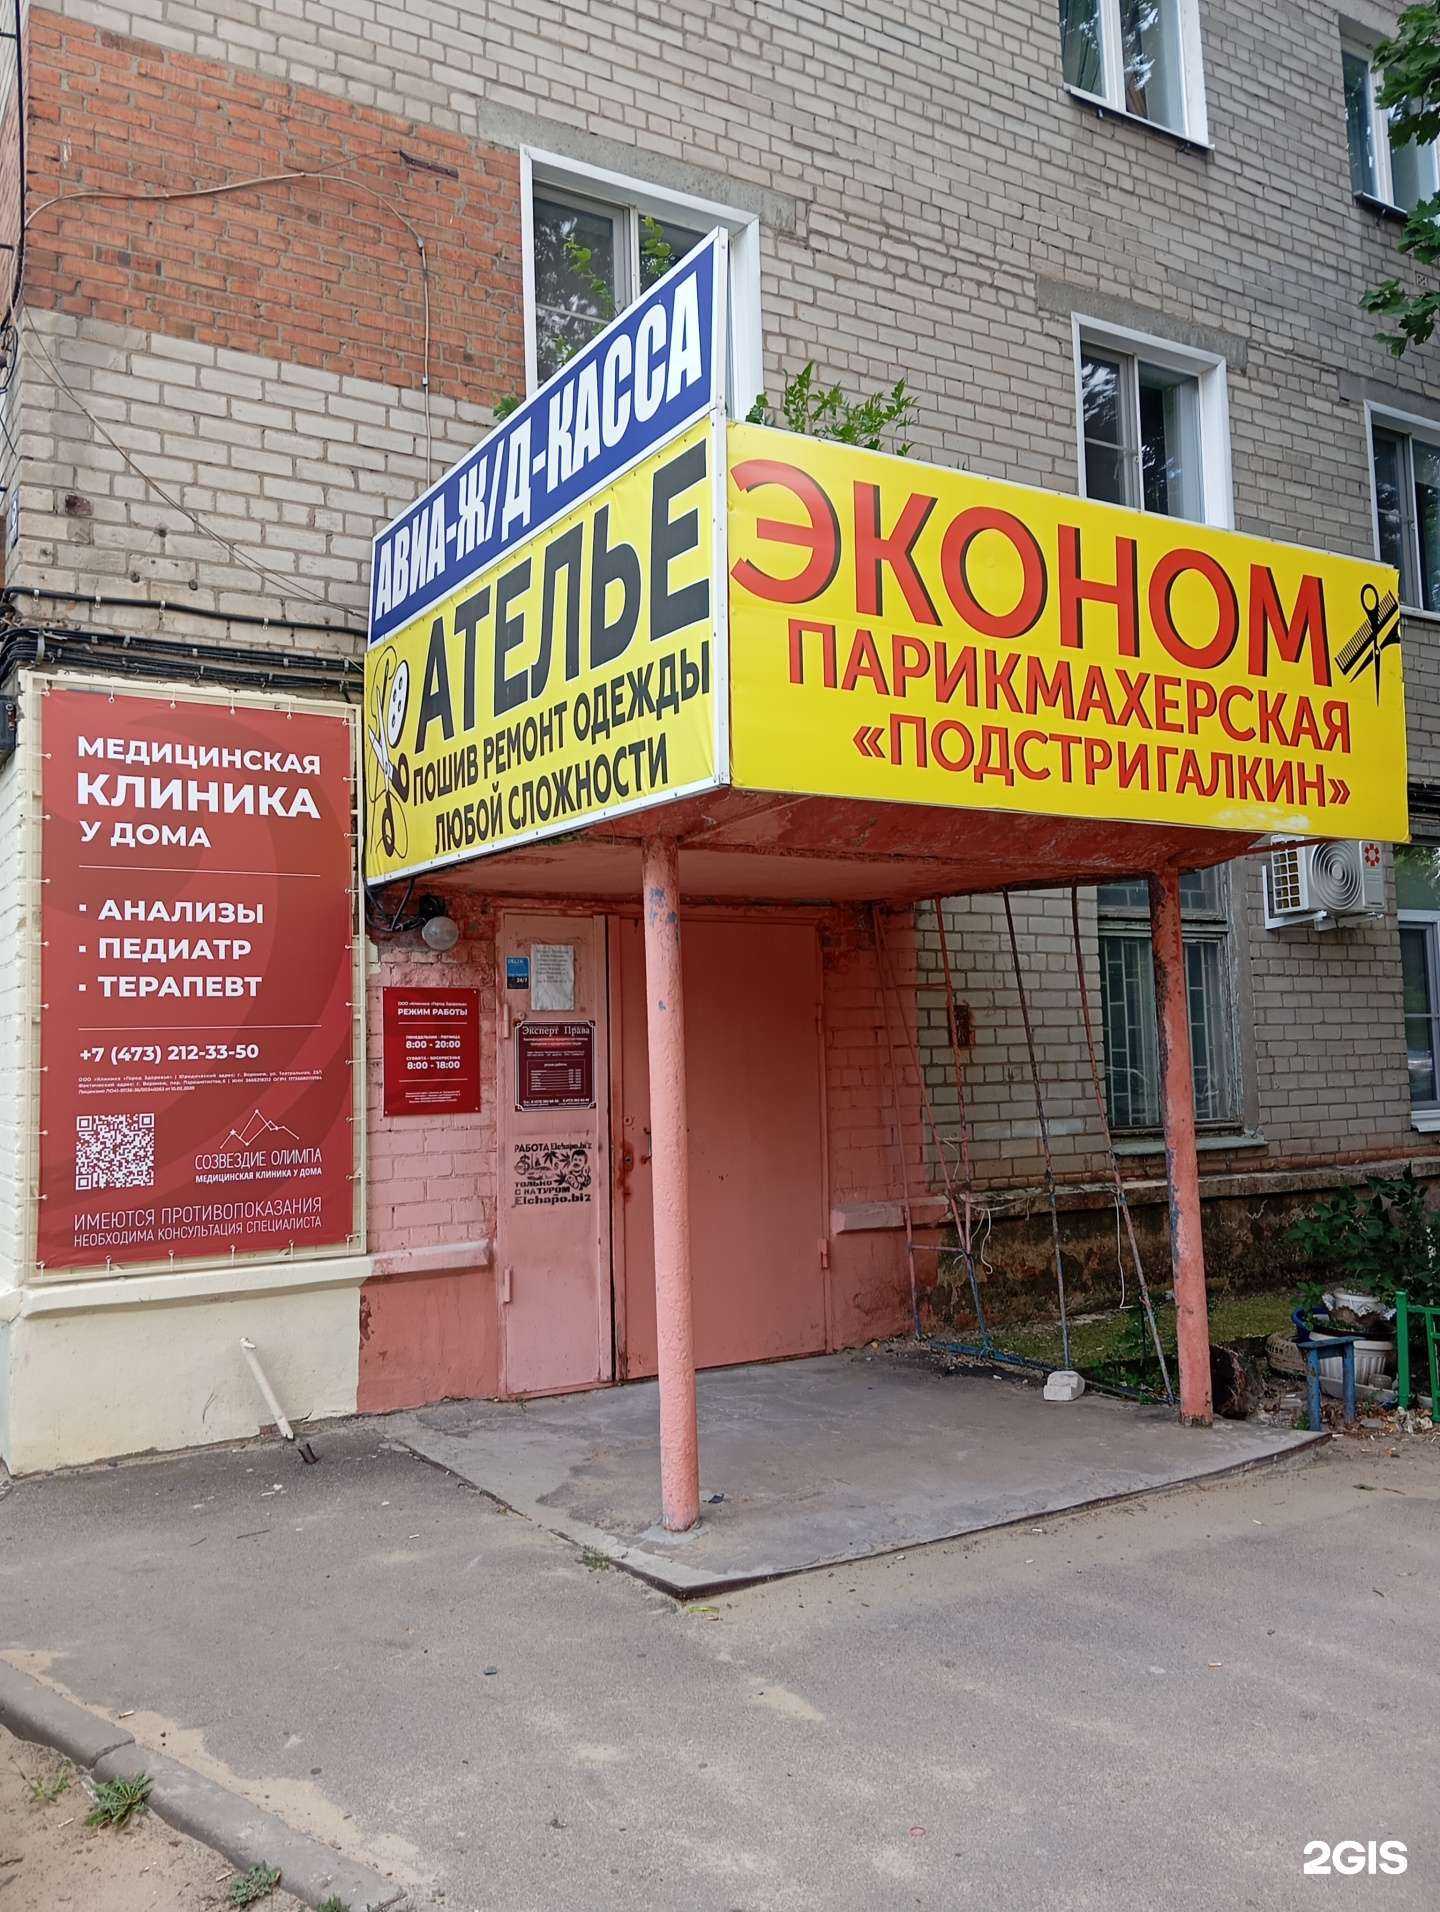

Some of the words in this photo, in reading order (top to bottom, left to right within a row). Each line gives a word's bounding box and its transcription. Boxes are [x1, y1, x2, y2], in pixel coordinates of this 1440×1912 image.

[374, 271, 703, 619] АВИА-Ж/Д-КАССА
[730, 458, 1332, 688] ЭКОНОМ
[415, 438, 710, 755] АТЕЛЬЕ
[788, 618, 1351, 754] ПАРИКМАХЕРСКАЯ
[413, 744, 478, 807] ПОШИВ
[484, 701, 568, 779] РЕМОНТ
[573, 640, 710, 745] ОДЕЖДЫ
[77, 735, 321, 775] МЕДИЦИНСКАЯ
[853, 712, 1351, 808] «ПОДСТРИГАЛКИН»
[77, 772, 321, 819] КЛИНИКА
[435, 782, 503, 855] ЛЮБОЙ
[508, 732, 668, 830] СЛОЖНОСТИ
[79, 820, 102, 843] У
[110, 822, 212, 848] ДОМА
[98, 899, 264, 924] АНАЛИЗЫ
[99, 937, 252, 963] ПЕДИАТР
[97, 976, 263, 998] ТЕРАПЕВТ
[398, 1008, 431, 1016] РЕЖИМ
[432, 1008, 468, 1016] РАБОТЫ
[405, 1040, 427, 1049] 8:00
[434, 1040, 461, 1048] 20:00
[522, 1026, 559, 1037] Эксперт
[564, 1026, 590, 1036] Права
[80, 1047, 105, 1062] +7
[111, 1045, 162, 1065] (473)
[167, 1044, 259, 1061] 212-33-50
[407, 1061, 428, 1070] 8:00
[435, 1061, 460, 1069] 18:00
[195, 1151, 266, 1171] СОЗВЕЗДИЕ
[271, 1148, 322, 1165] ОЛИМПА
[514, 1143, 550, 1153] РАБОТА
[195, 1172, 253, 1184] МЕДИЦИНСКАЯ
[255, 1169, 292, 1180] КЛИНИКА
[293, 1169, 298, 1178] У
[299, 1167, 322, 1177] ДОМА
[74, 1208, 155, 1231] ИМЕЮТСЯ
[161, 1197, 322, 1225] ПРОТИВОПОКАЗАНИЯ
[74, 1228, 154, 1247] НЕОБХОДИМА
[158, 1222, 243, 1240] КОНСУЛЬТАЦИЯ
[246, 1216, 322, 1234] СПЕЦИАЛИСТА
